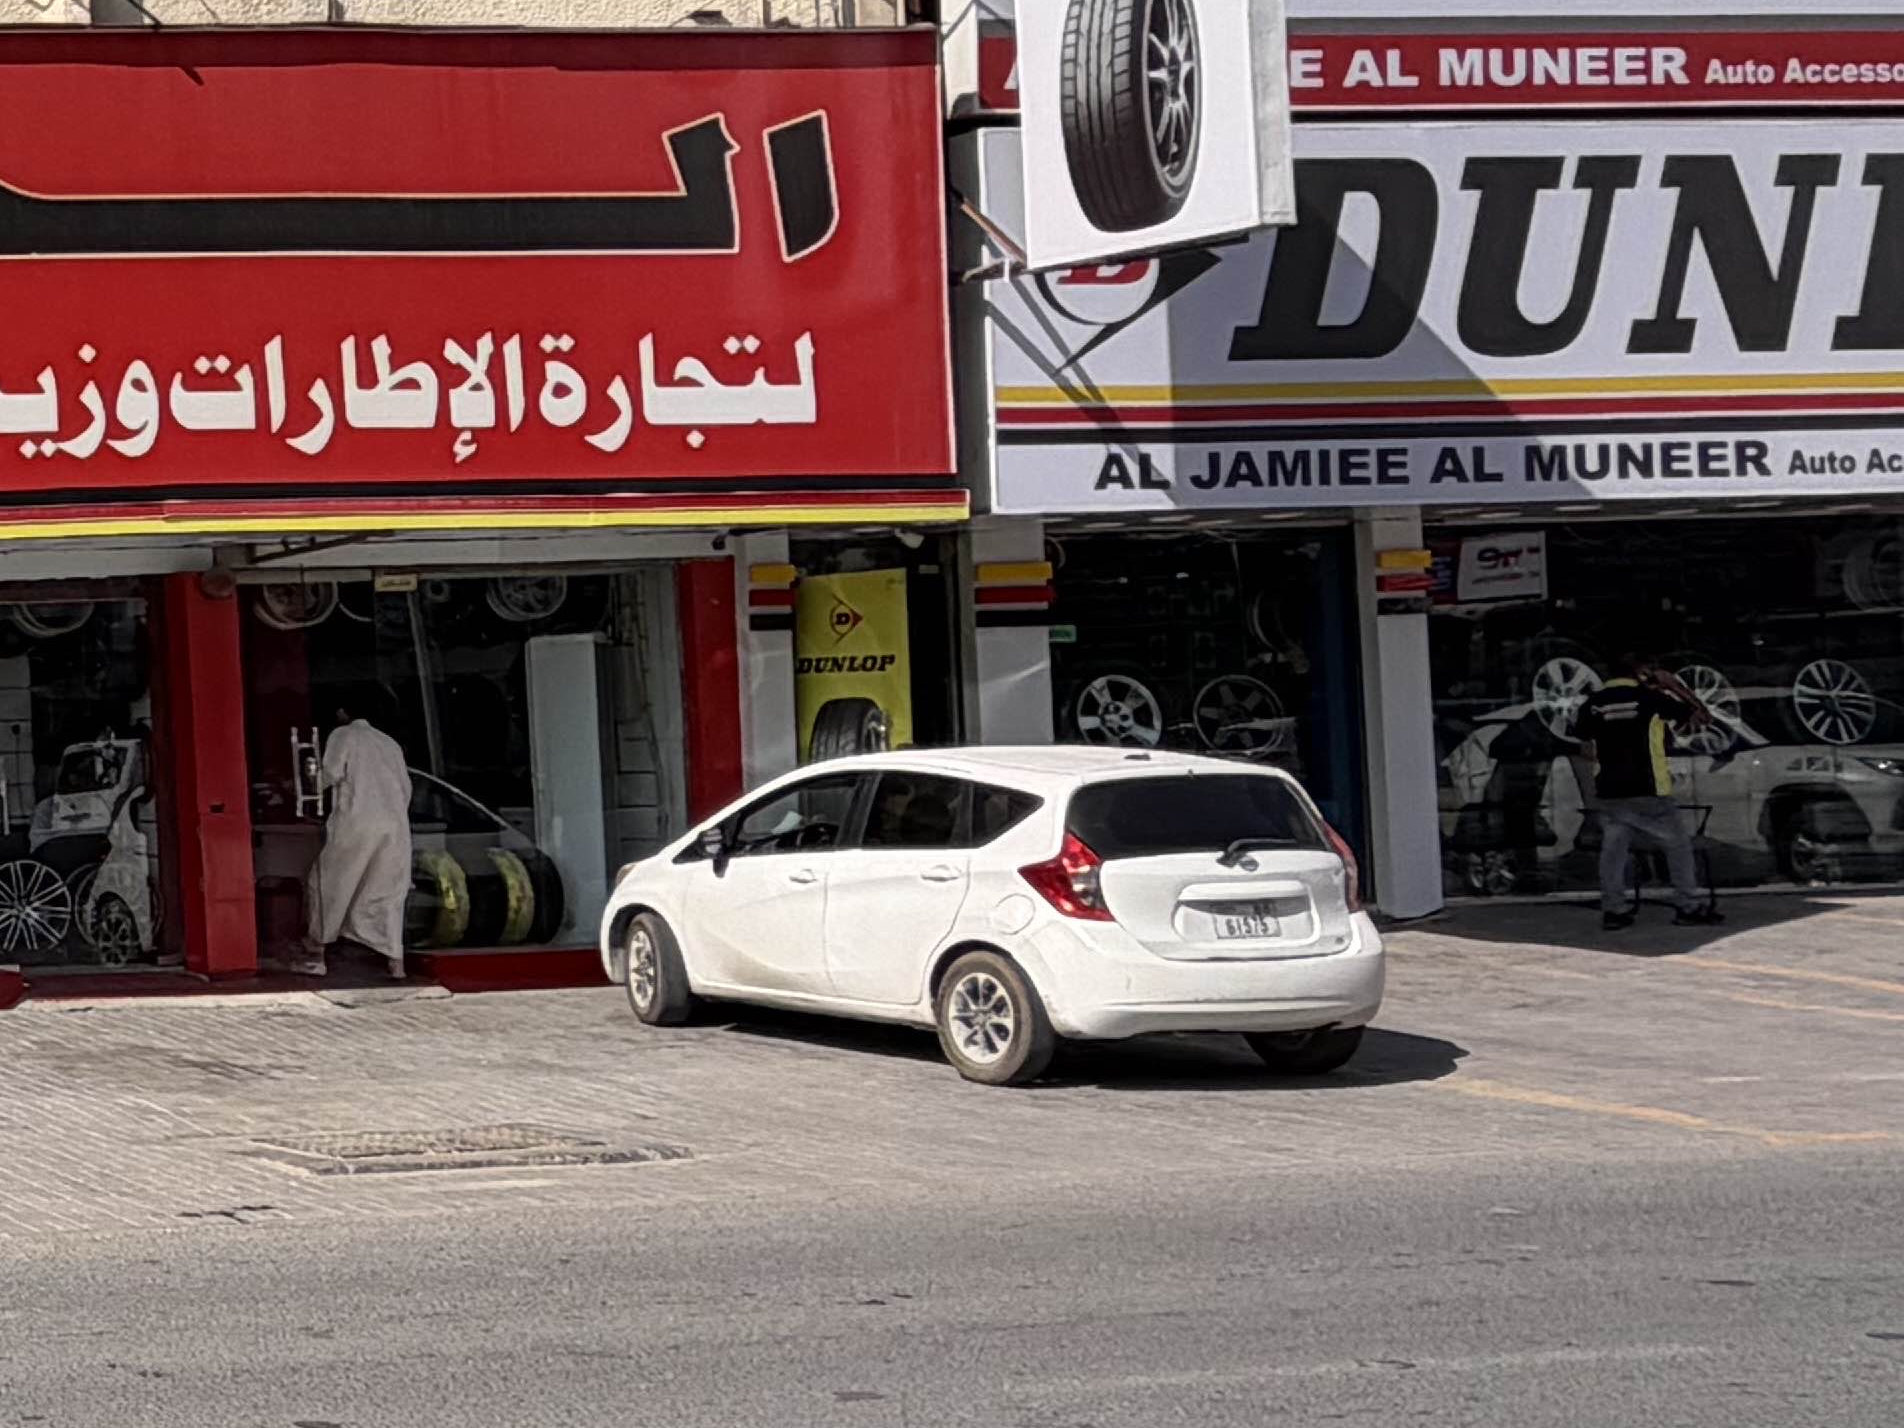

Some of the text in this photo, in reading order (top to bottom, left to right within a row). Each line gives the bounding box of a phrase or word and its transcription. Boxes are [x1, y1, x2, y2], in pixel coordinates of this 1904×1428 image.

[1342, 48, 1420, 88] AL
[1439, 46, 1690, 86] MUNEER
[1705, 58, 1776, 84] Auto
[539, 330, 819, 453] لتجارة
[1094, 452, 1171, 490] AL
[1190, 447, 1410, 489] JAMIEE
[1429, 446, 1504, 484] AL
[1524, 440, 1772, 482] MUNEER
[1788, 449, 1856, 475] Auto
[796, 654, 896, 673] DUNLOP
